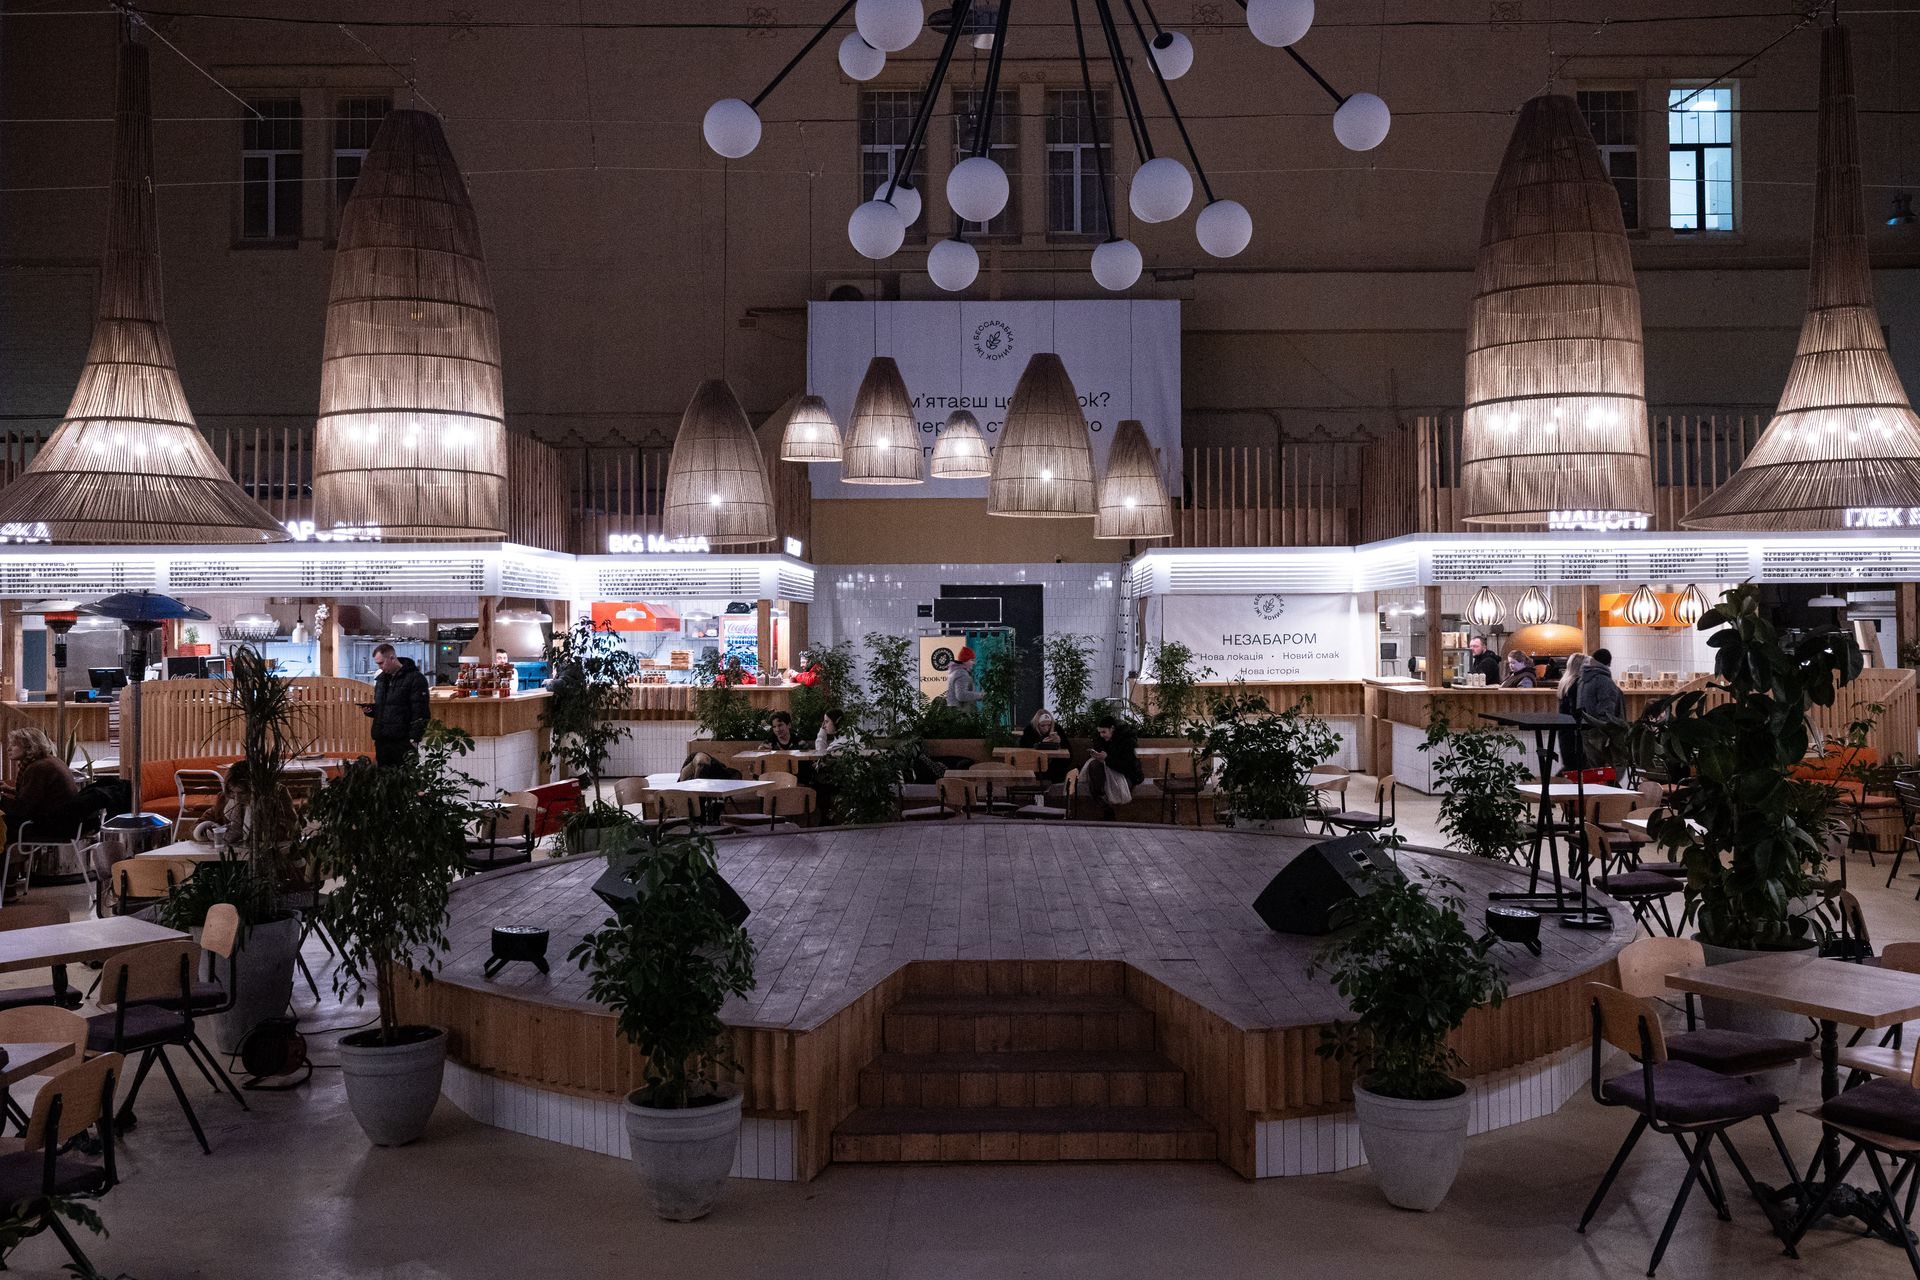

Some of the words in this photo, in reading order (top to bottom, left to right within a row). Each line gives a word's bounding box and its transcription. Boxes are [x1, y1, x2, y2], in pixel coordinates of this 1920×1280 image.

[973, 320, 1014, 342] БЕССАРАБКА
[986, 344, 1013, 361] РИНОК
[609, 534, 643, 552] BIG
[1222, 633, 1317, 646] НЕЗАБАРОМ
[1200, 653, 1225, 661] Нова
[1226, 652, 1264, 661] локація
[1282, 651, 1314, 660] Новий
[1315, 651, 1340, 659] смак
[1240, 667, 1265, 676] Нова
[1266, 667, 1300, 676] історія
